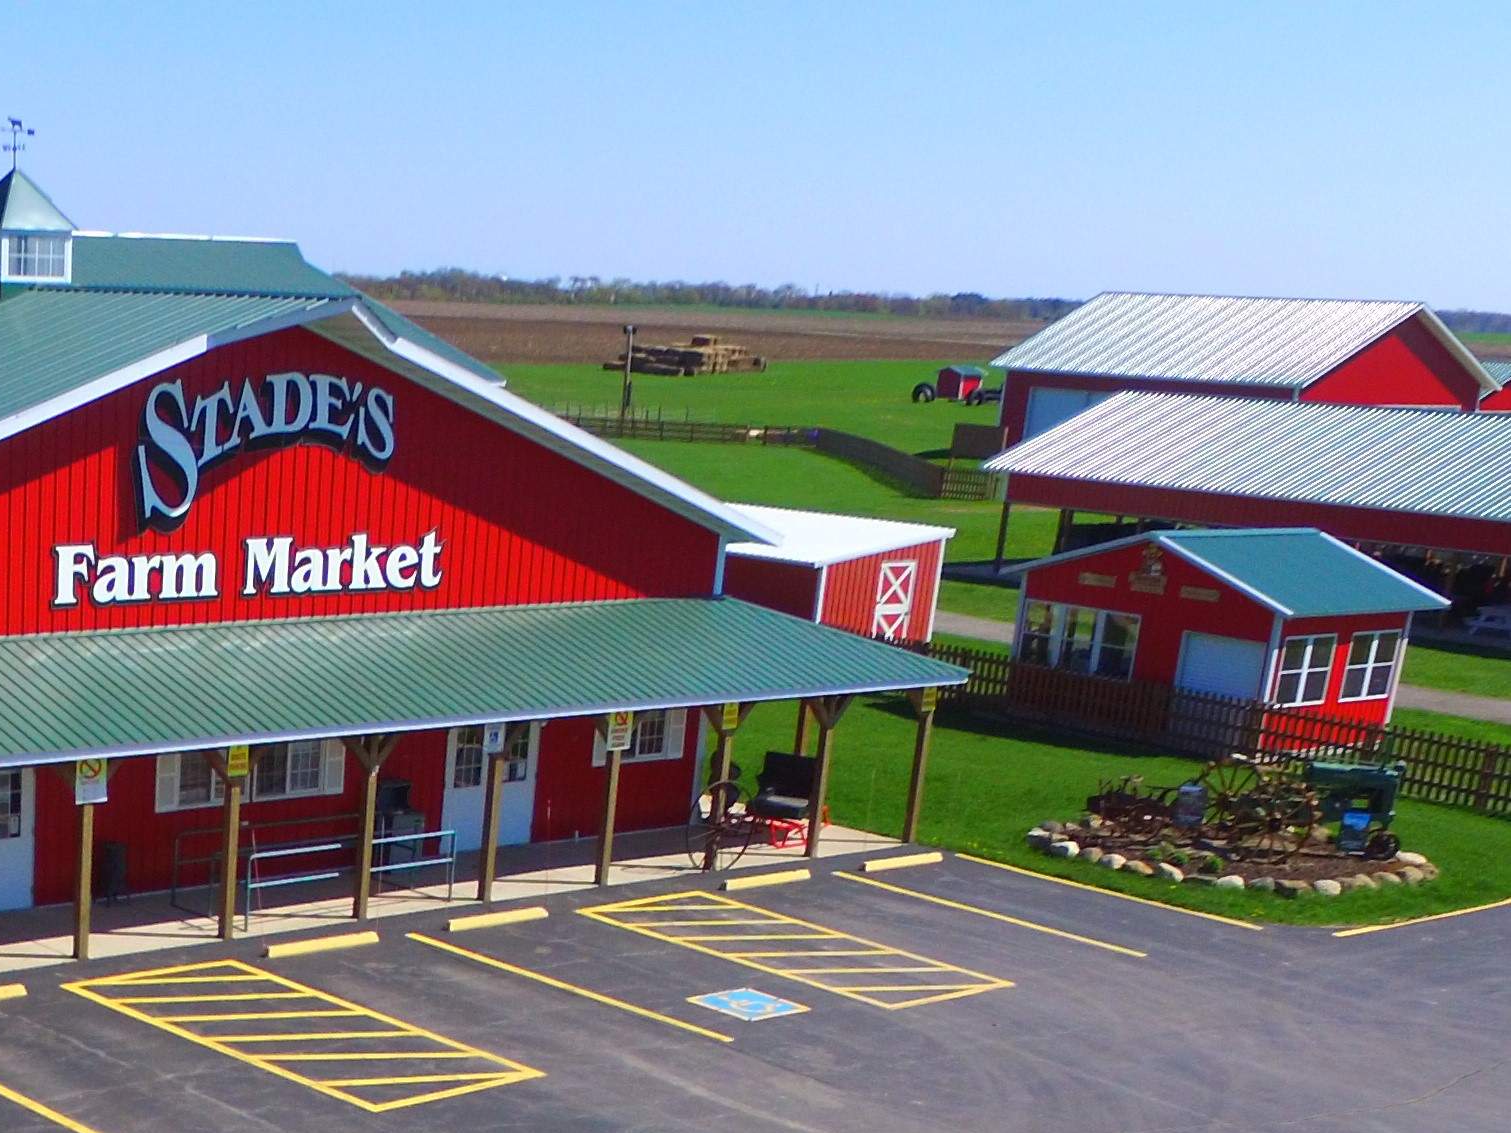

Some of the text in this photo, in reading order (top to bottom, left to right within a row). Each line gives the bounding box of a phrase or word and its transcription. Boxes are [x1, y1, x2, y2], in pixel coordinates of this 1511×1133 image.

[138, 371, 396, 519] STADE'S
[52, 528, 445, 607] Farm Market
